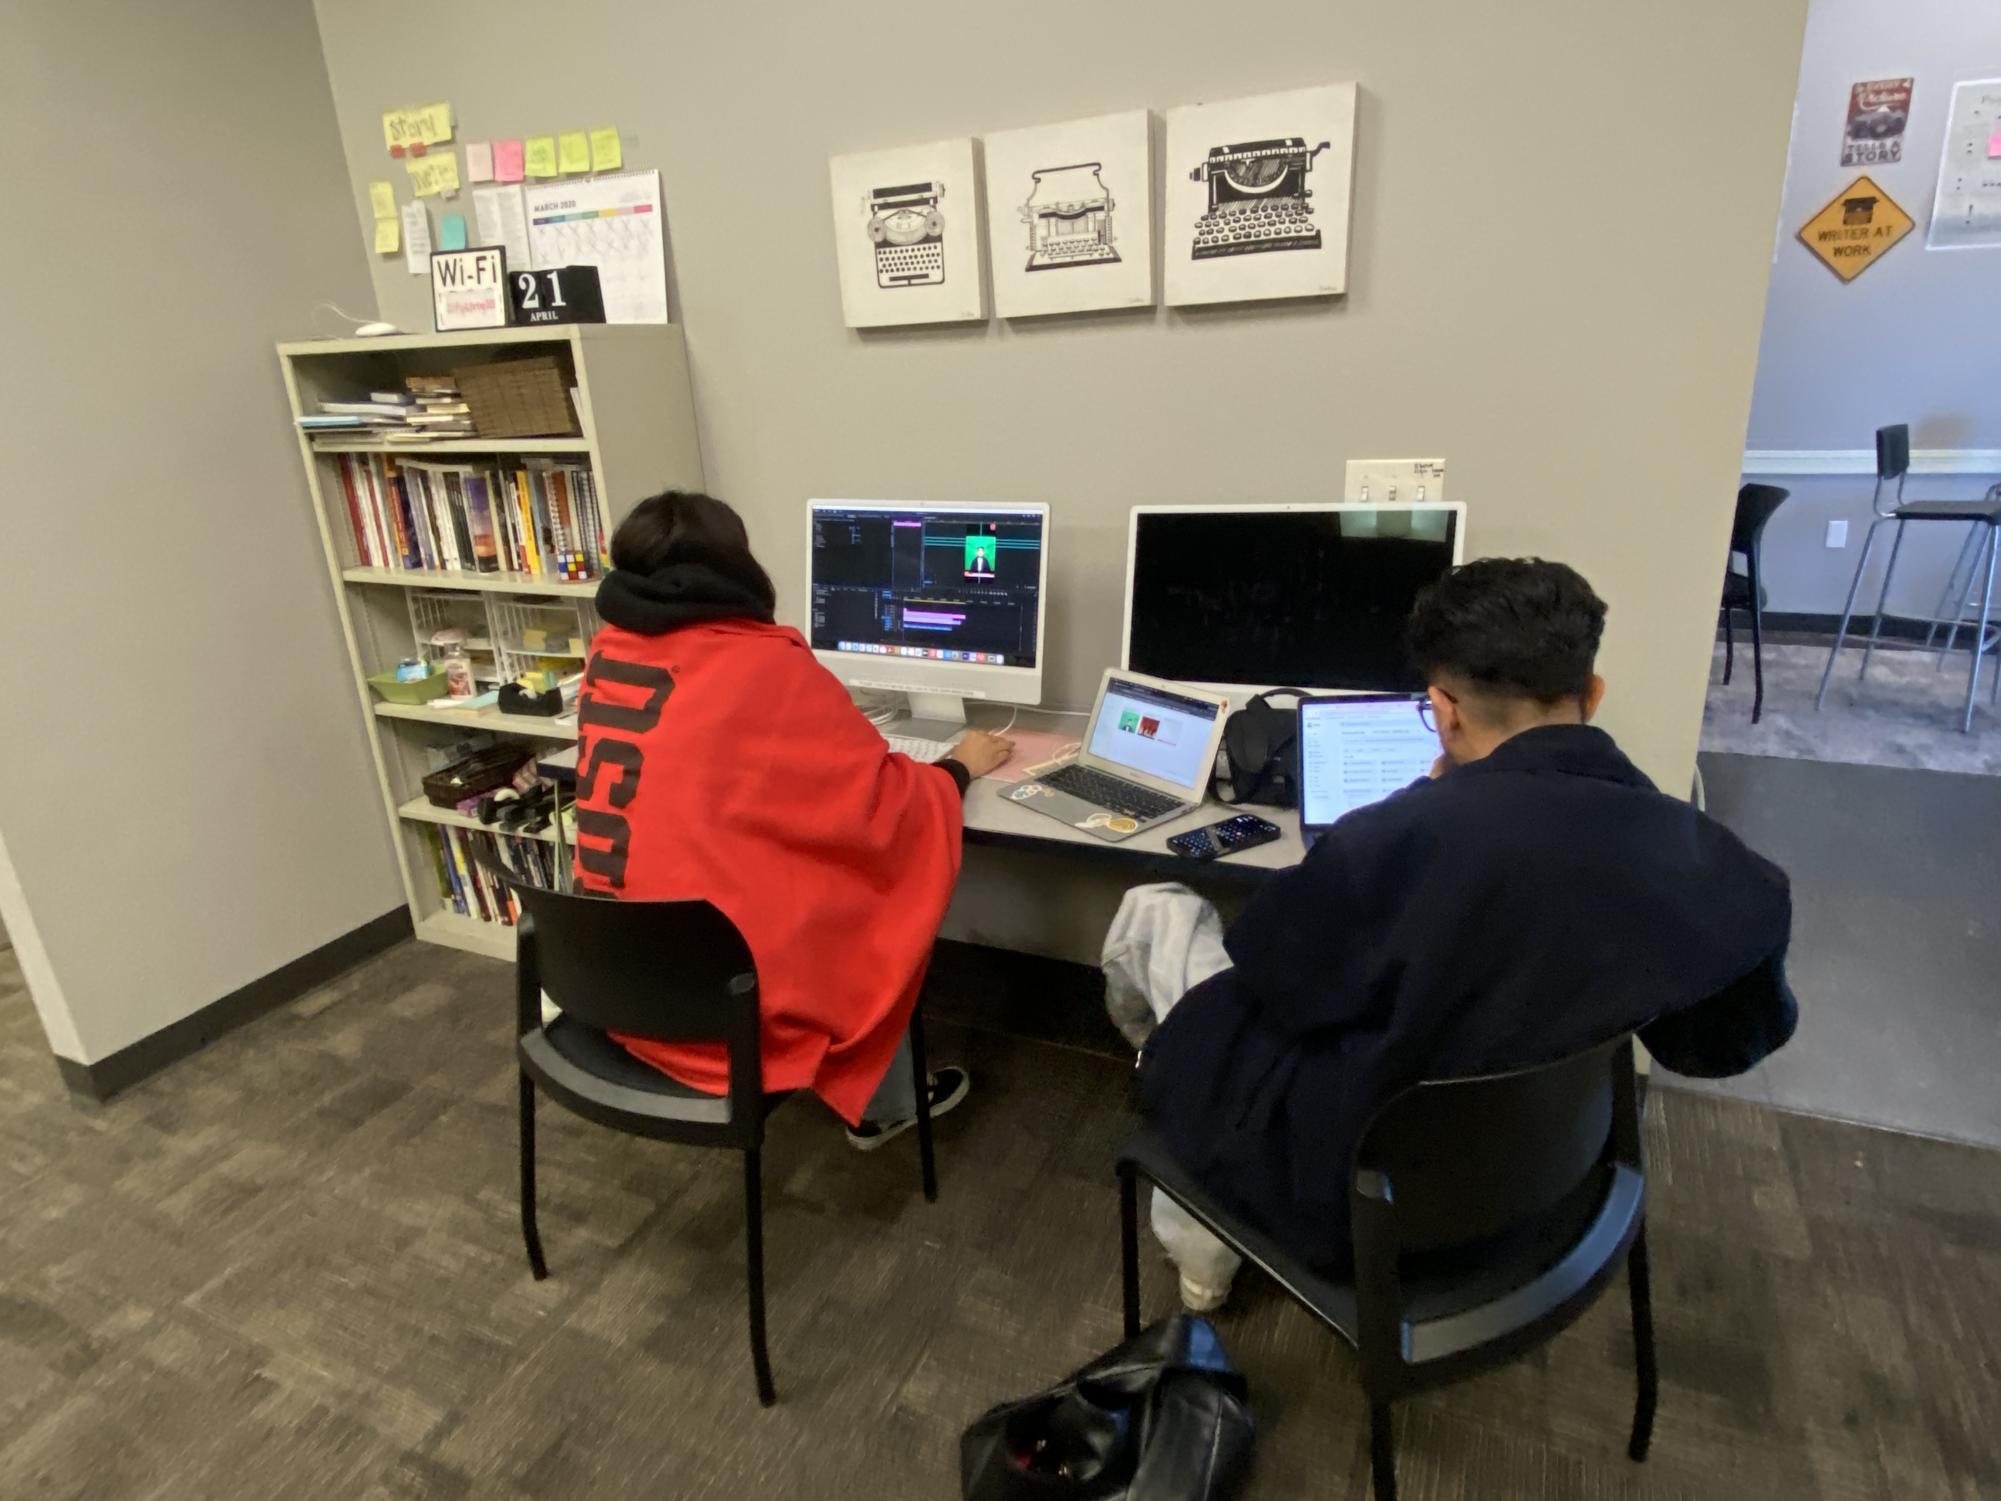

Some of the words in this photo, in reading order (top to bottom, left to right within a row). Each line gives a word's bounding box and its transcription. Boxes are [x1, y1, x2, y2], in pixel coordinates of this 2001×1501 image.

[1845, 150, 1900, 163] STORY
[534, 202, 559, 213] MARCH
[1817, 227, 1869, 242] WRITER
[1873, 225, 1893, 237] AT
[1832, 246, 1871, 257] WORK
[518, 270, 566, 309] 21
[530, 311, 559, 322] APRIL
